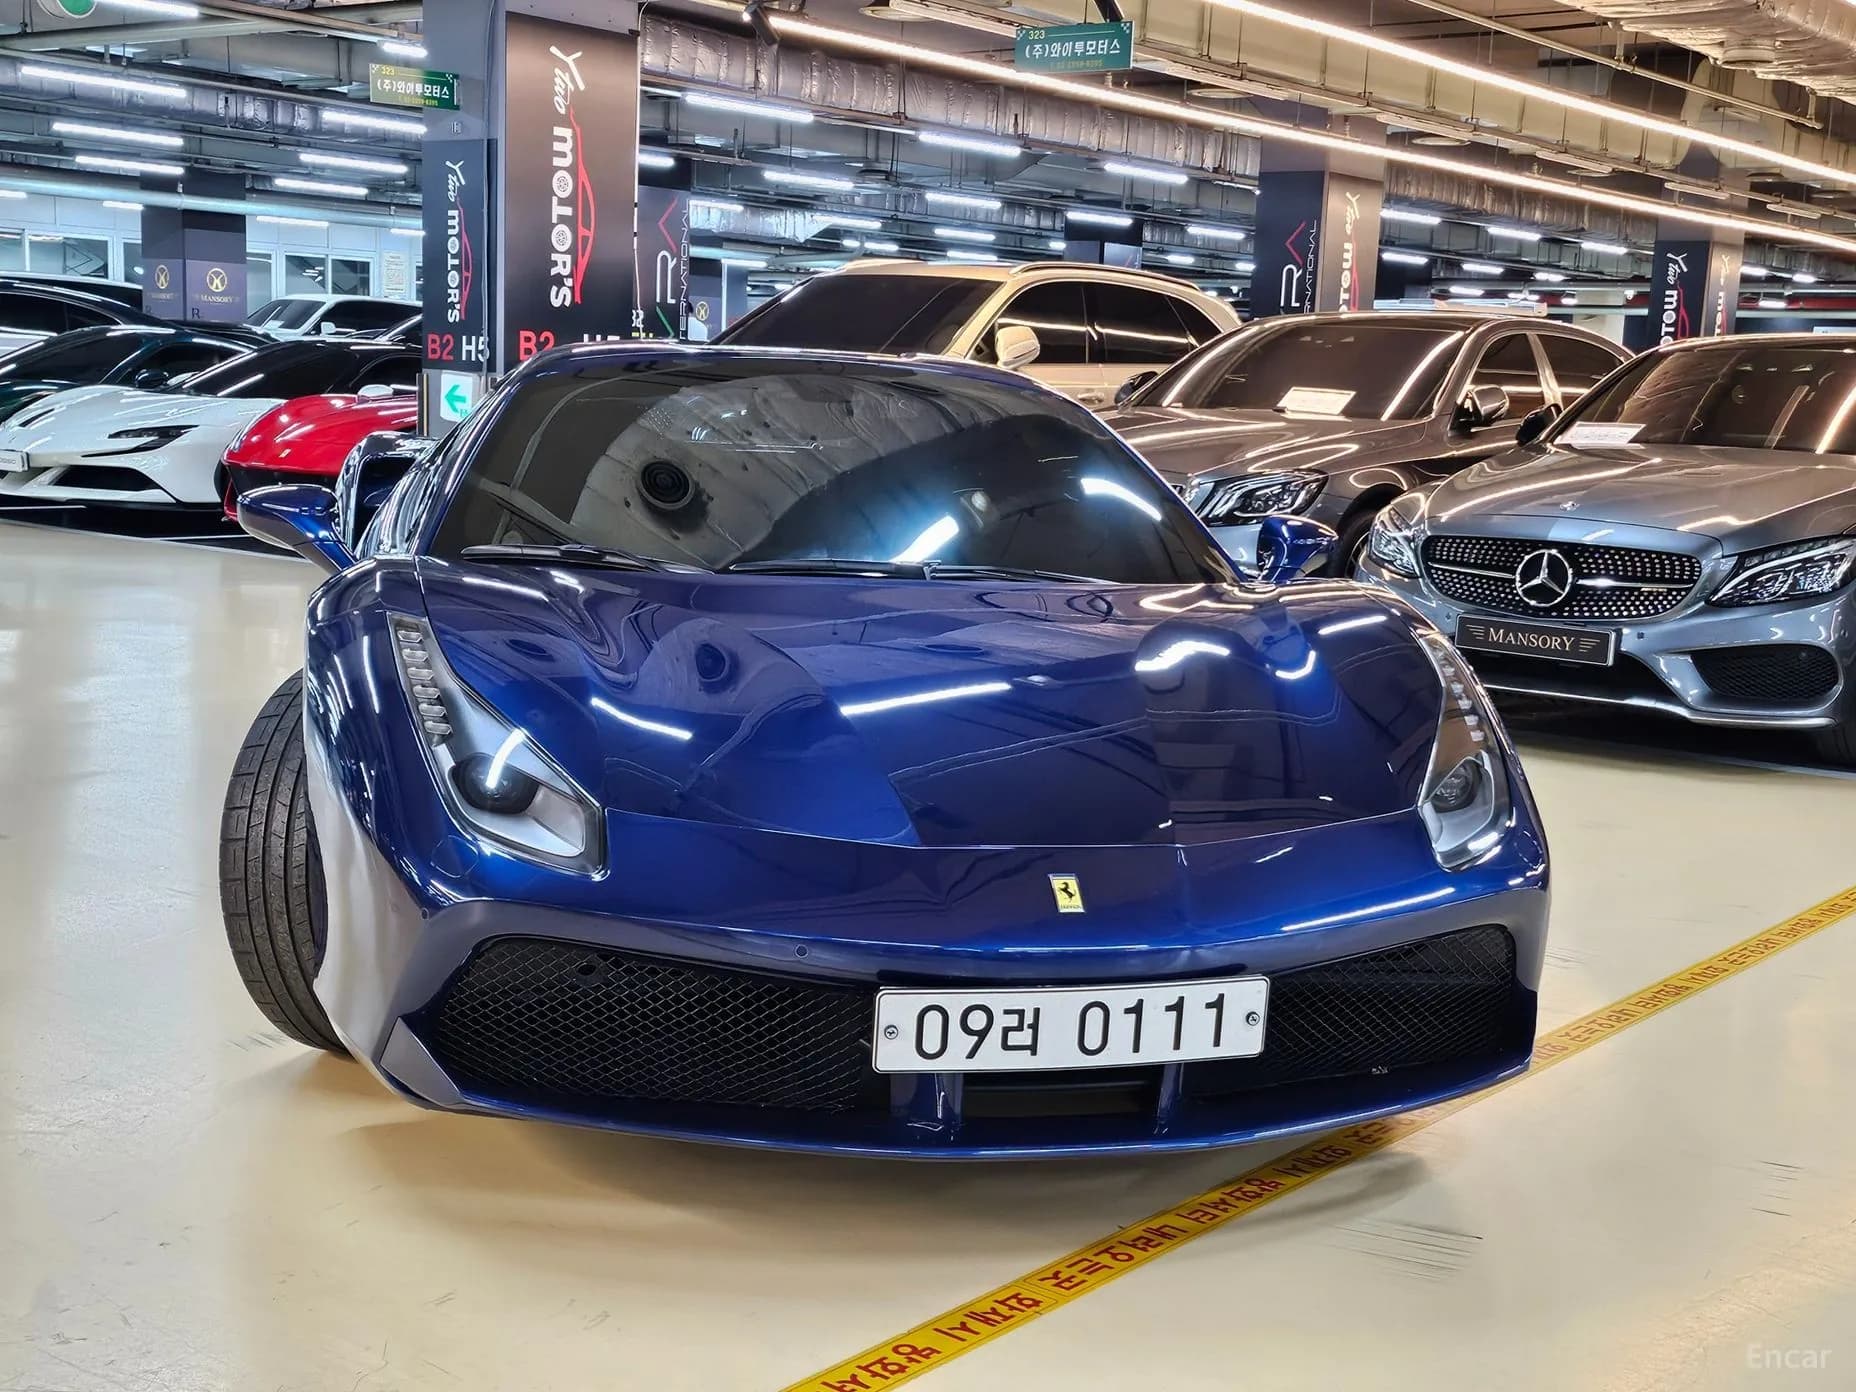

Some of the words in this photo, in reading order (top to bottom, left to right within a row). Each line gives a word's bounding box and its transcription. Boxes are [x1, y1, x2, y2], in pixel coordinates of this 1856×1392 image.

[1025, 39, 1121, 59] (주)와이투모터스
[1028, 30, 1046, 40] 323
[380, 65, 395, 76] 323
[377, 79, 450, 99] (주)와이투모터스
[427, 333, 454, 361] B2
[462, 335, 490, 362] H5
[1487, 627, 1576, 651] MANSORY
[914, 1003, 1041, 1060] 09러
[1076, 992, 1226, 1057] 0111
[1176, 1177, 1286, 1224] 방화셔터
[1038, 1223, 1188, 1291] 내려오는곳
[932, 1292, 1044, 1342] 화재시
[819, 1343, 942, 1392] 방화셔
